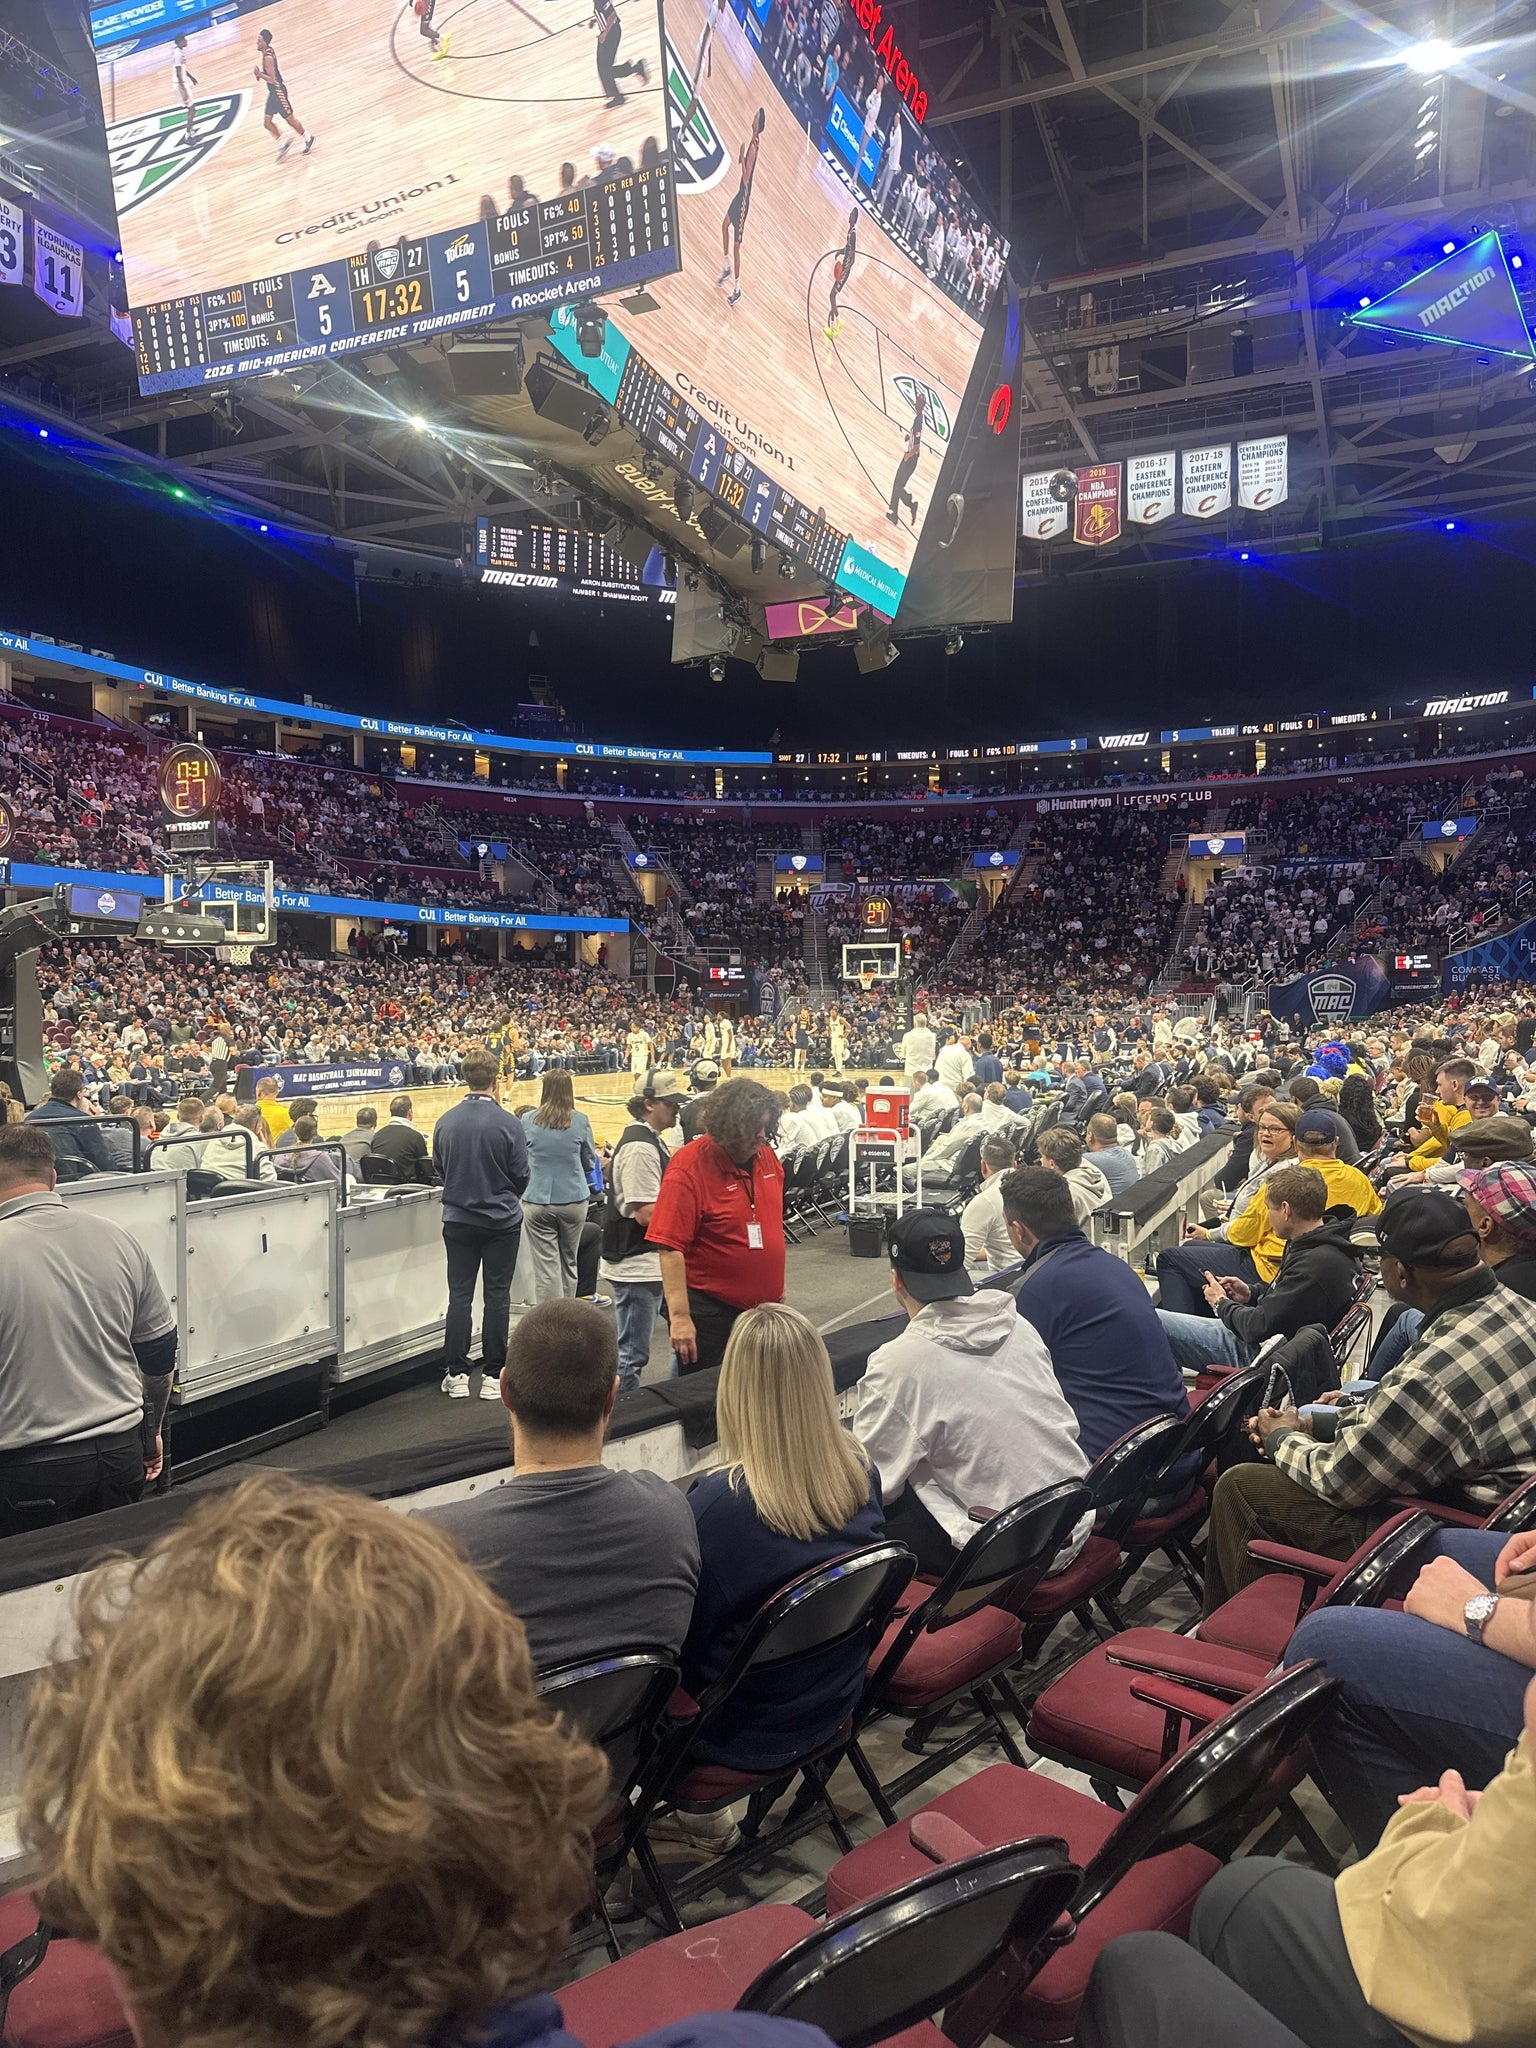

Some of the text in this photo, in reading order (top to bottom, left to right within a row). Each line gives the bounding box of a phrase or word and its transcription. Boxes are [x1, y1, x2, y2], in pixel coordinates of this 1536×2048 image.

[876, 25, 928, 124] Arena
[604, 166, 667, 194] PTS REB AST FLS
[275, 210, 359, 245] Credit
[362, 181, 443, 214] Union
[543, 198, 580, 221] FG% 40
[336, 206, 404, 235] cu1.com
[496, 210, 530, 233] FOULS
[37, 226, 80, 257] ZYDRUNAS
[510, 230, 518, 246] 0
[543, 225, 584, 249] 3PT% 50
[37, 236, 81, 267] ILGAUSKAS
[407, 246, 422, 268] 27
[444, 242, 475, 264] TOLEDO
[494, 248, 520, 266] BONUS
[350, 253, 368, 268] HALF
[378, 256, 398, 268] MAC
[44, 256, 74, 303] 11
[353, 267, 370, 288] 1H
[509, 256, 574, 287] TIMEOUTS: 4
[252, 275, 283, 296] FOULS
[307, 273, 337, 299] A
[456, 269, 470, 302] 5
[523, 275, 601, 307] Rocket Arena
[207, 290, 242, 308] FG% 100
[266, 295, 273, 309] 0
[362, 280, 423, 323] 17:32
[1417, 265, 1496, 328] MACTION
[208, 313, 246, 332] 3PT% 100
[251, 311, 276, 325] BONUS
[318, 304, 332, 336] 5
[204, 303, 496, 379] 2026 MID-AMERICAN CONFERENCE TOURNAMENT
[223, 330, 283, 354] TIMEOUTS: 4
[675, 372, 785, 464] Credit Union
[704, 433, 716, 456] A
[713, 422, 757, 458] cu1.com
[1239, 441, 1286, 454] CENTRAL DIVISION
[1135, 457, 1167, 469] 2016-17
[1189, 451, 1223, 463] 2017-18
[1241, 448, 1284, 461] CHAMPIONS
[700, 458, 709, 482] 5
[744, 465, 753, 481] 27
[1089, 468, 1107, 478] 2016
[1136, 469, 1166, 481] EASTERN
[1190, 462, 1222, 474] EASTERN
[1090, 481, 1105, 491] NBA
[1130, 478, 1173, 492] CONFERENCE
[1184, 471, 1228, 485] CONFERENCE
[718, 473, 744, 510] 17:32
[1078, 488, 1117, 501] CHAMPIONS
[1131, 488, 1171, 501] CHAMPIONS
[1186, 481, 1227, 494] CHAMPIONS
[752, 502, 762, 524] 5
[1027, 505, 1064, 517] CHAMPIONS
[479, 529, 487, 553] TOLEDO
[854, 565, 898, 599] MEDICAL MUTUAL
[15, 638, 30, 651] All.
[144, 672, 257, 708] CU1 Better Banking For All.
[38, 713, 50, 722] 122
[1280, 718, 1313, 731] FOULS 0
[1331, 711, 1377, 726] TIMEOUTS: 4
[360, 718, 474, 743] CU1 Better Banking For All.
[1172, 726, 1235, 742] 5 TOLEDO
[1242, 722, 1274, 735] FG% 40
[575, 744, 684, 760] CU1 Better Banking For All.
[950, 748, 978, 758] FOULS 0
[986, 745, 1016, 756] FG% 100
[1019, 739, 1077, 753] AKRON 5
[795, 753, 805, 763] 27
[817, 753, 841, 764] 17:32
[872, 752, 881, 761] 1H
[897, 750, 937, 760] TIMEOUTS: 4
[177, 760, 208, 779] 17:31
[175, 778, 206, 810] 27
[178, 821, 210, 832] TISSOT
[215, 887, 243, 901] Better
[282, 894, 297, 906] For
[297, 896, 311, 908] All.
[418, 909, 527, 926] CU1 Better Banking For All.
[867, 910, 884, 924] 27
[1314, 996, 1351, 1010] MAC
[308, 1070, 345, 1082] BASKETBALL
[346, 1068, 382, 1078] TOURNAMENT
